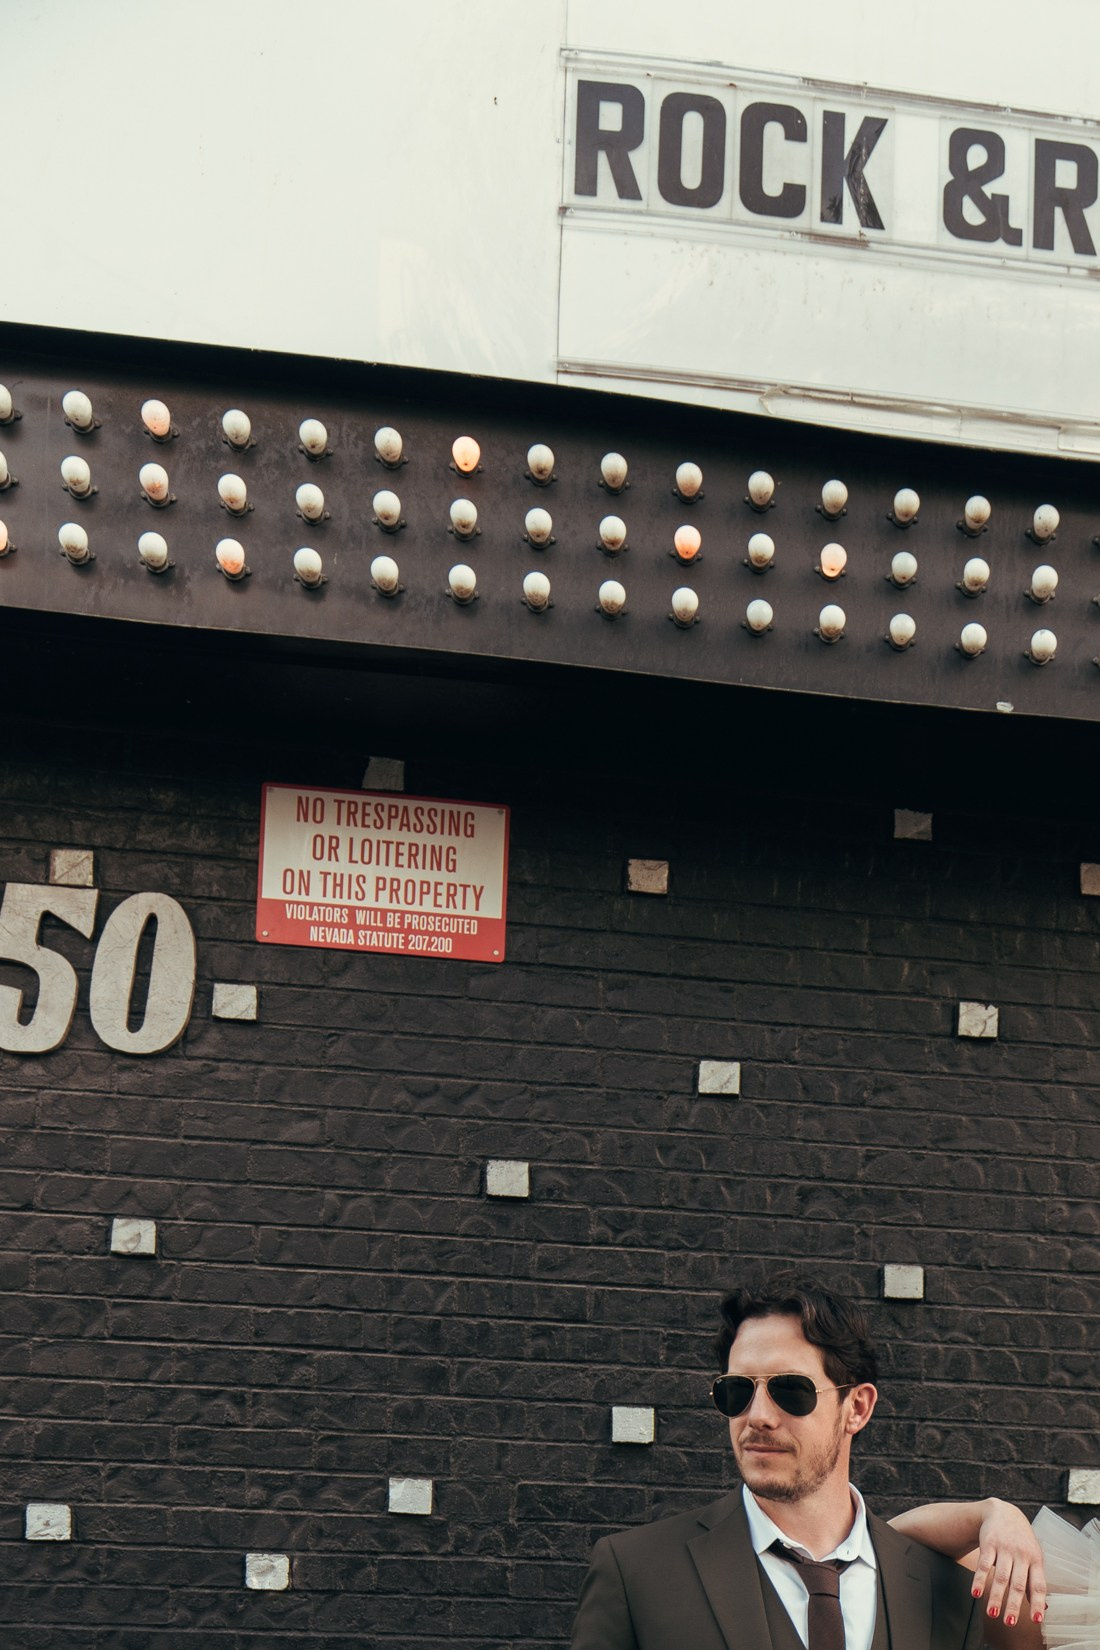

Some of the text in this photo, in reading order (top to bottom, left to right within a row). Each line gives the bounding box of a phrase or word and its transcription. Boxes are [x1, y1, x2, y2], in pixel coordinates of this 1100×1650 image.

[574, 79, 888, 231] ROCK
[296, 795, 475, 838] NO TRESPASSING
[312, 834, 457, 873] OR LOITERING
[282, 868, 484, 911] ON THIS PROPERTY
[285, 903, 478, 935] VIOLATORS WILL BE PROSECUTED
[309, 926, 453, 953] NEVADA STATUTE 207.200
[0, 882, 197, 1054] 50
